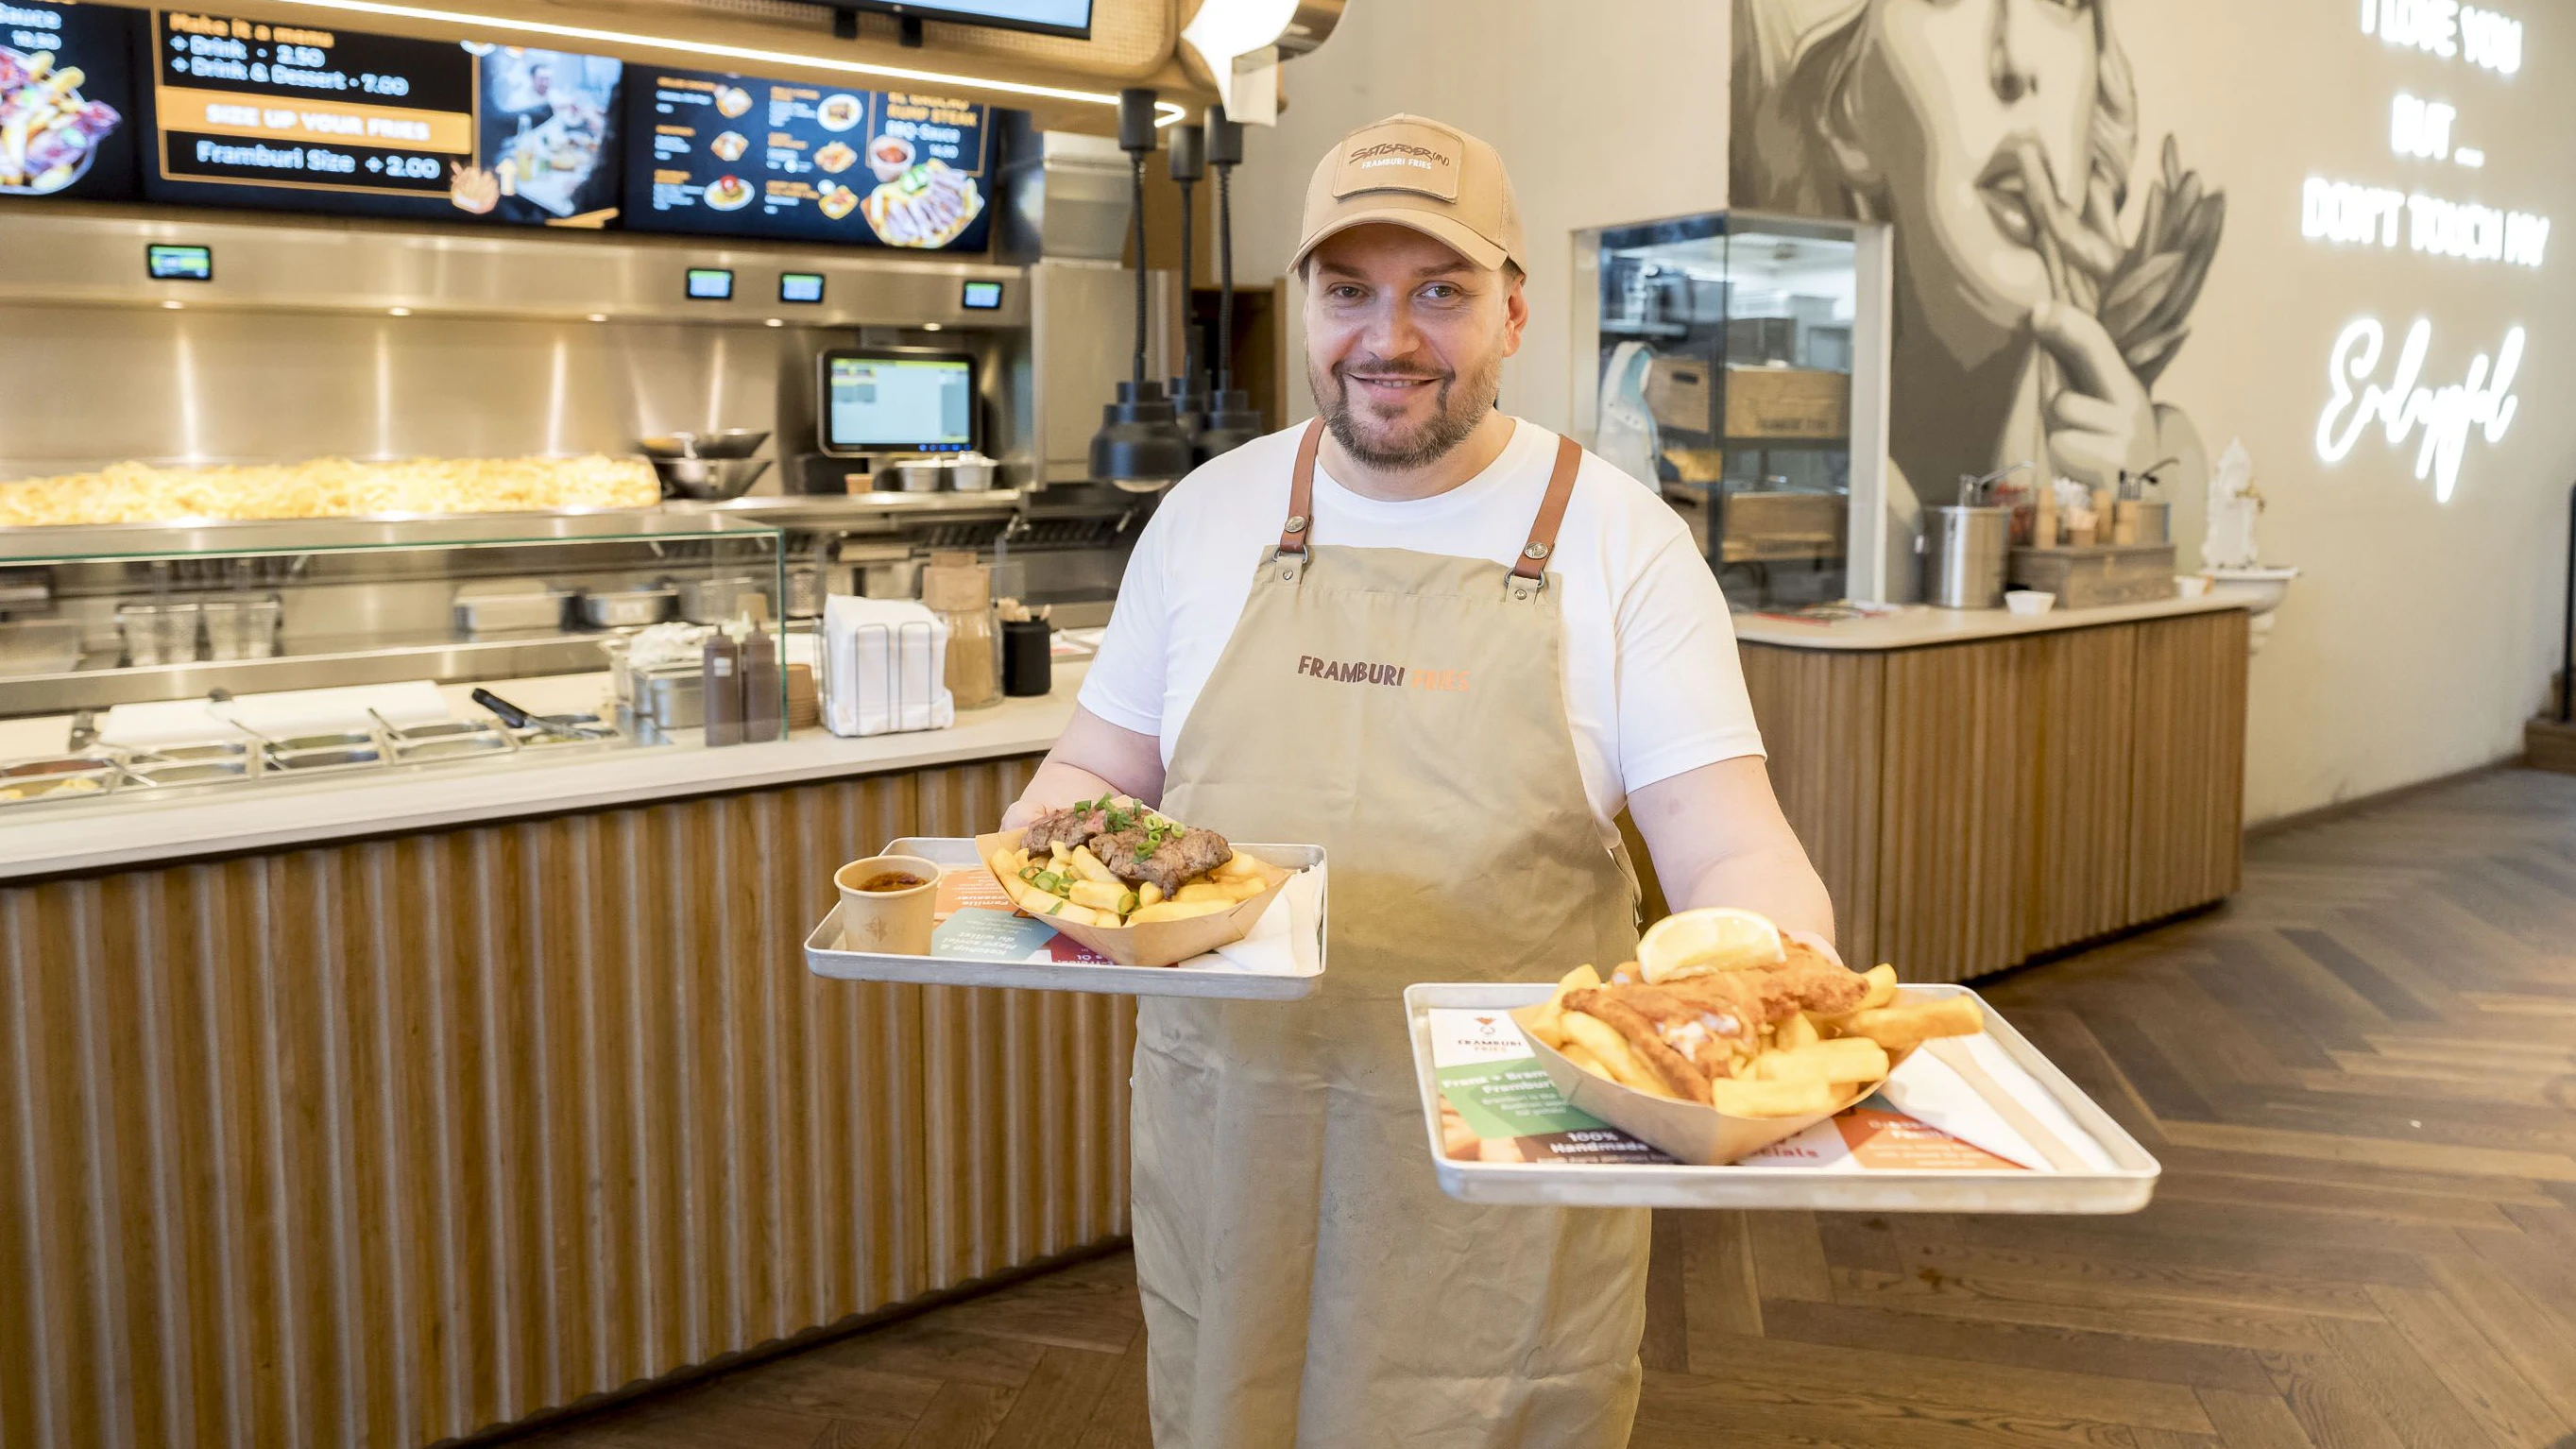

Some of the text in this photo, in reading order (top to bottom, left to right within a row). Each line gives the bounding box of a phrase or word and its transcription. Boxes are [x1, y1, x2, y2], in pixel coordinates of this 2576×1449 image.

[169, 13, 229, 37] Make
[2460, 6, 2522, 75] YOU
[190, 35, 247, 60] Drink
[191, 57, 248, 80] Drink
[271, 64, 347, 90] Dessert
[206, 104, 430, 141] SIZE UP YOUR FRIES
[196, 140, 303, 168] Framburi
[306, 149, 356, 173] Size
[1361, 157, 1432, 170] FRAMBURI FRIES
[1297, 655, 1406, 687] FRAMBURI
[1567, 1131, 1618, 1142] 100%
